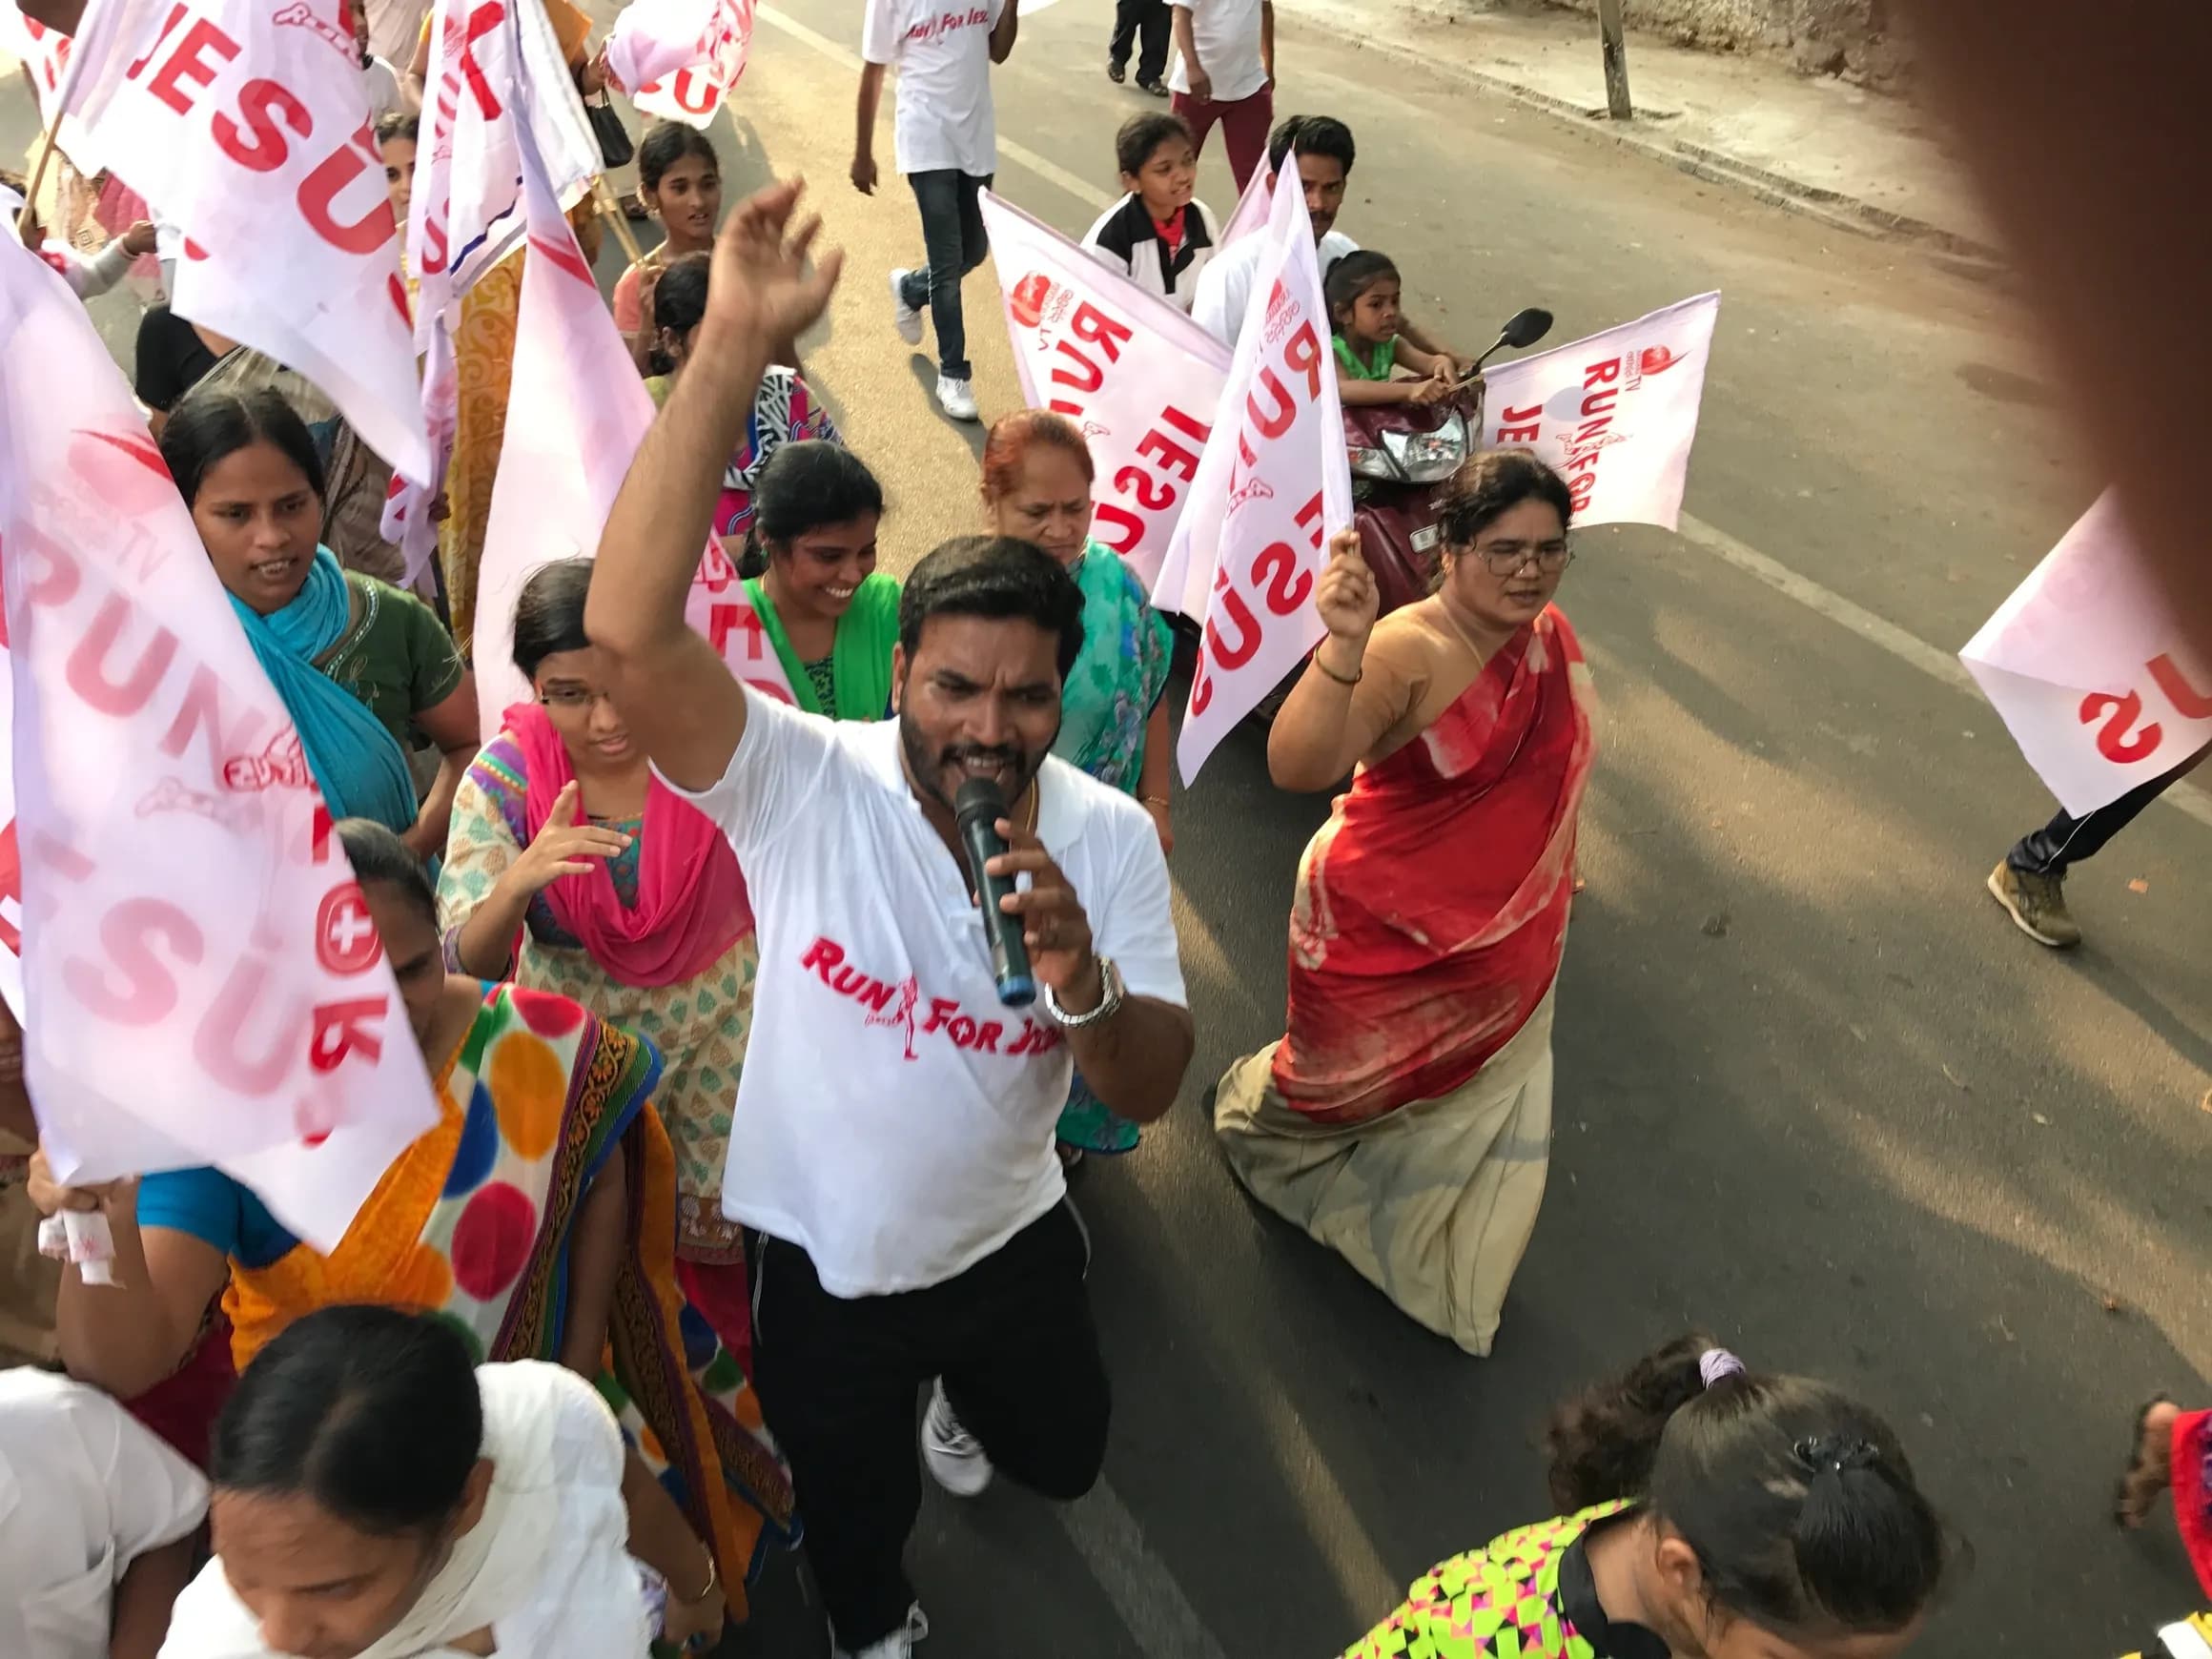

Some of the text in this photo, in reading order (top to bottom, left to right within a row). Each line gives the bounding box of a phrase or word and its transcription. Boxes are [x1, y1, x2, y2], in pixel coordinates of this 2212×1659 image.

[126, 2, 414, 332] JESU
[1574, 357, 1621, 444] RUN
[1625, 376, 1642, 393] TV
[116, 520, 174, 584] TV
[799, 935, 898, 1014] RUN
[921, 996, 1004, 1055] FOR
